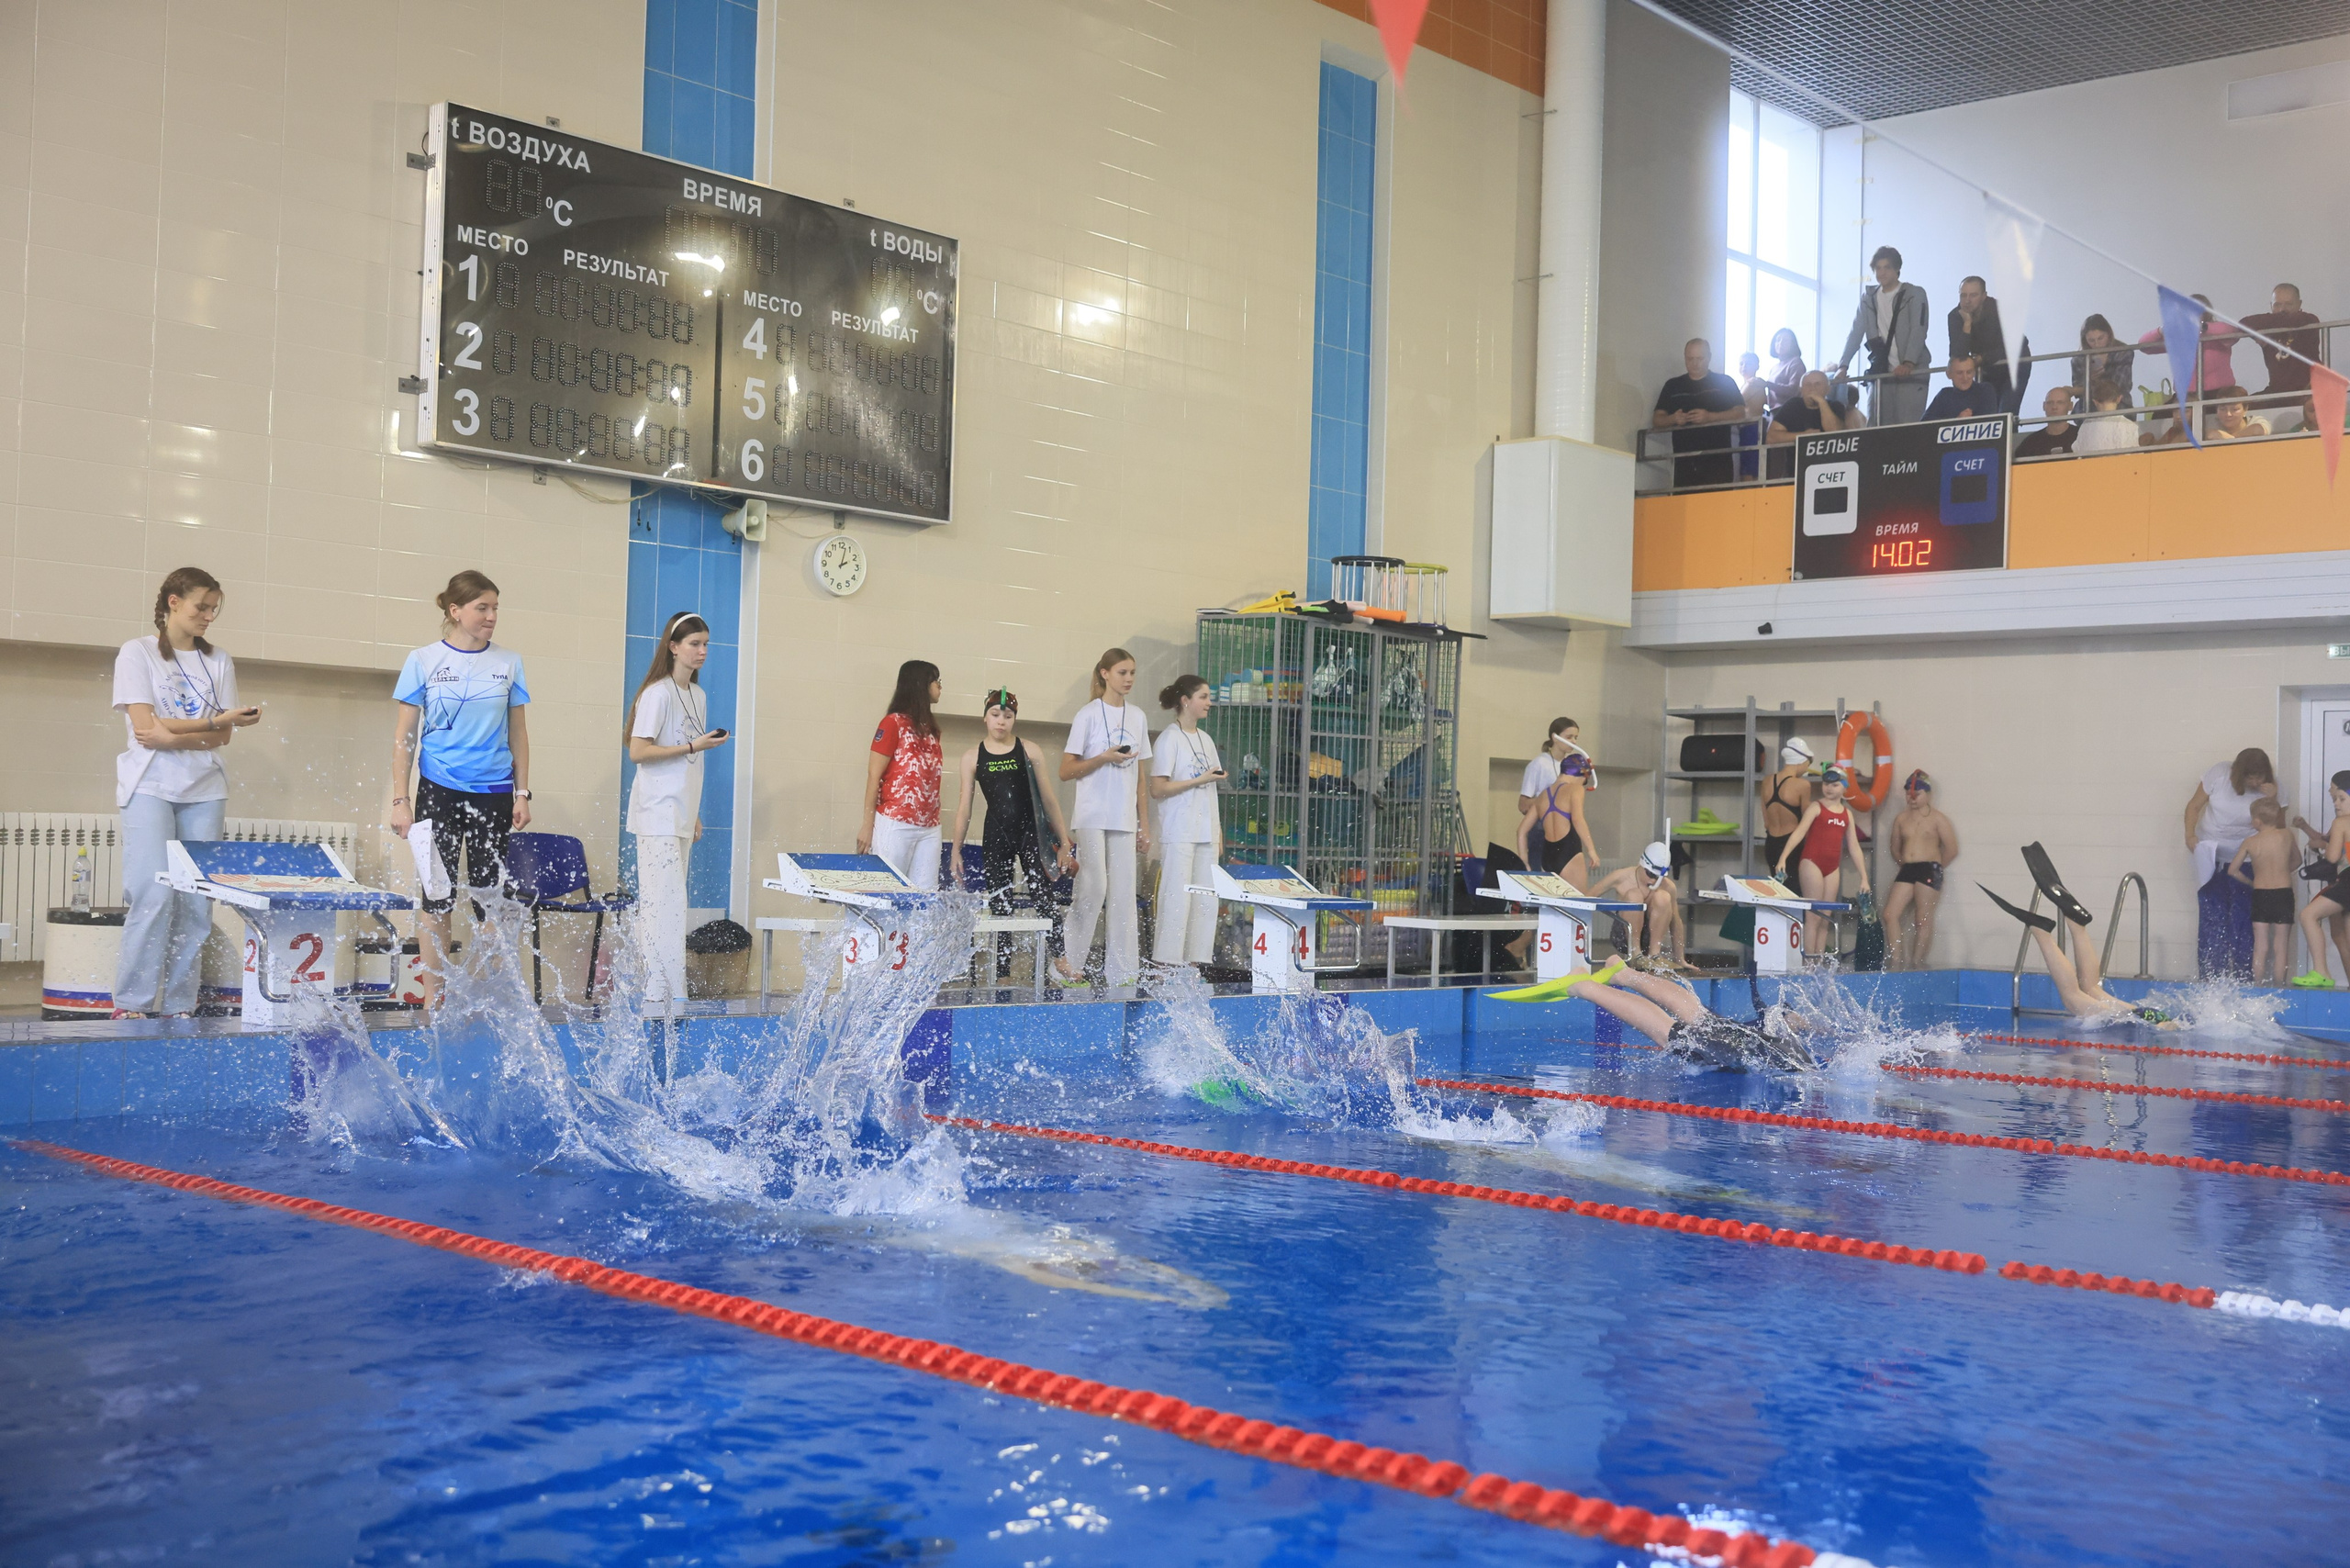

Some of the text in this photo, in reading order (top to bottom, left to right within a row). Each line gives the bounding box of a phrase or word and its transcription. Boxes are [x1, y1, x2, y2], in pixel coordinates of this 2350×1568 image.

[451, 118, 591, 174] t ВОЗДУХА
[683, 178, 762, 218] ВРЕМЯ
[457, 224, 529, 256] МЕСТО
[870, 229, 943, 265] t ВОДЫ
[458, 254, 478, 302] 1
[564, 249, 670, 288] РЕЗУЛЬТАТ
[744, 289, 802, 318] МЕСТО
[743, 318, 767, 360] 4
[831, 310, 919, 344] РЕЗУЛЬТАТ
[453, 321, 484, 371] 2
[452, 388, 481, 437] 3
[742, 377, 766, 420] 5
[1806, 437, 1860, 456] БЕЛЫЕ
[1939, 421, 2002, 443] СИНИЕ
[741, 438, 765, 482] 6
[1882, 461, 1918, 476] ТАЙМ
[1954, 458, 1986, 472] СЧЕТ
[1818, 471, 1846, 484] СЧЕТ
[1875, 522, 1919, 536] ВРЕМЯ
[995, 763, 1018, 771] CMAS
[1828, 818, 1845, 827] FILA
[845, 936, 858, 964] 3
[888, 930, 910, 970] 3
[1254, 933, 1267, 955] 4
[1292, 925, 1310, 959] 4
[1539, 933, 1552, 953] 5
[1757, 926, 1769, 945] 6
[1790, 922, 1801, 949] 6
[244, 938, 257, 973] 2
[289, 932, 326, 984] 2
